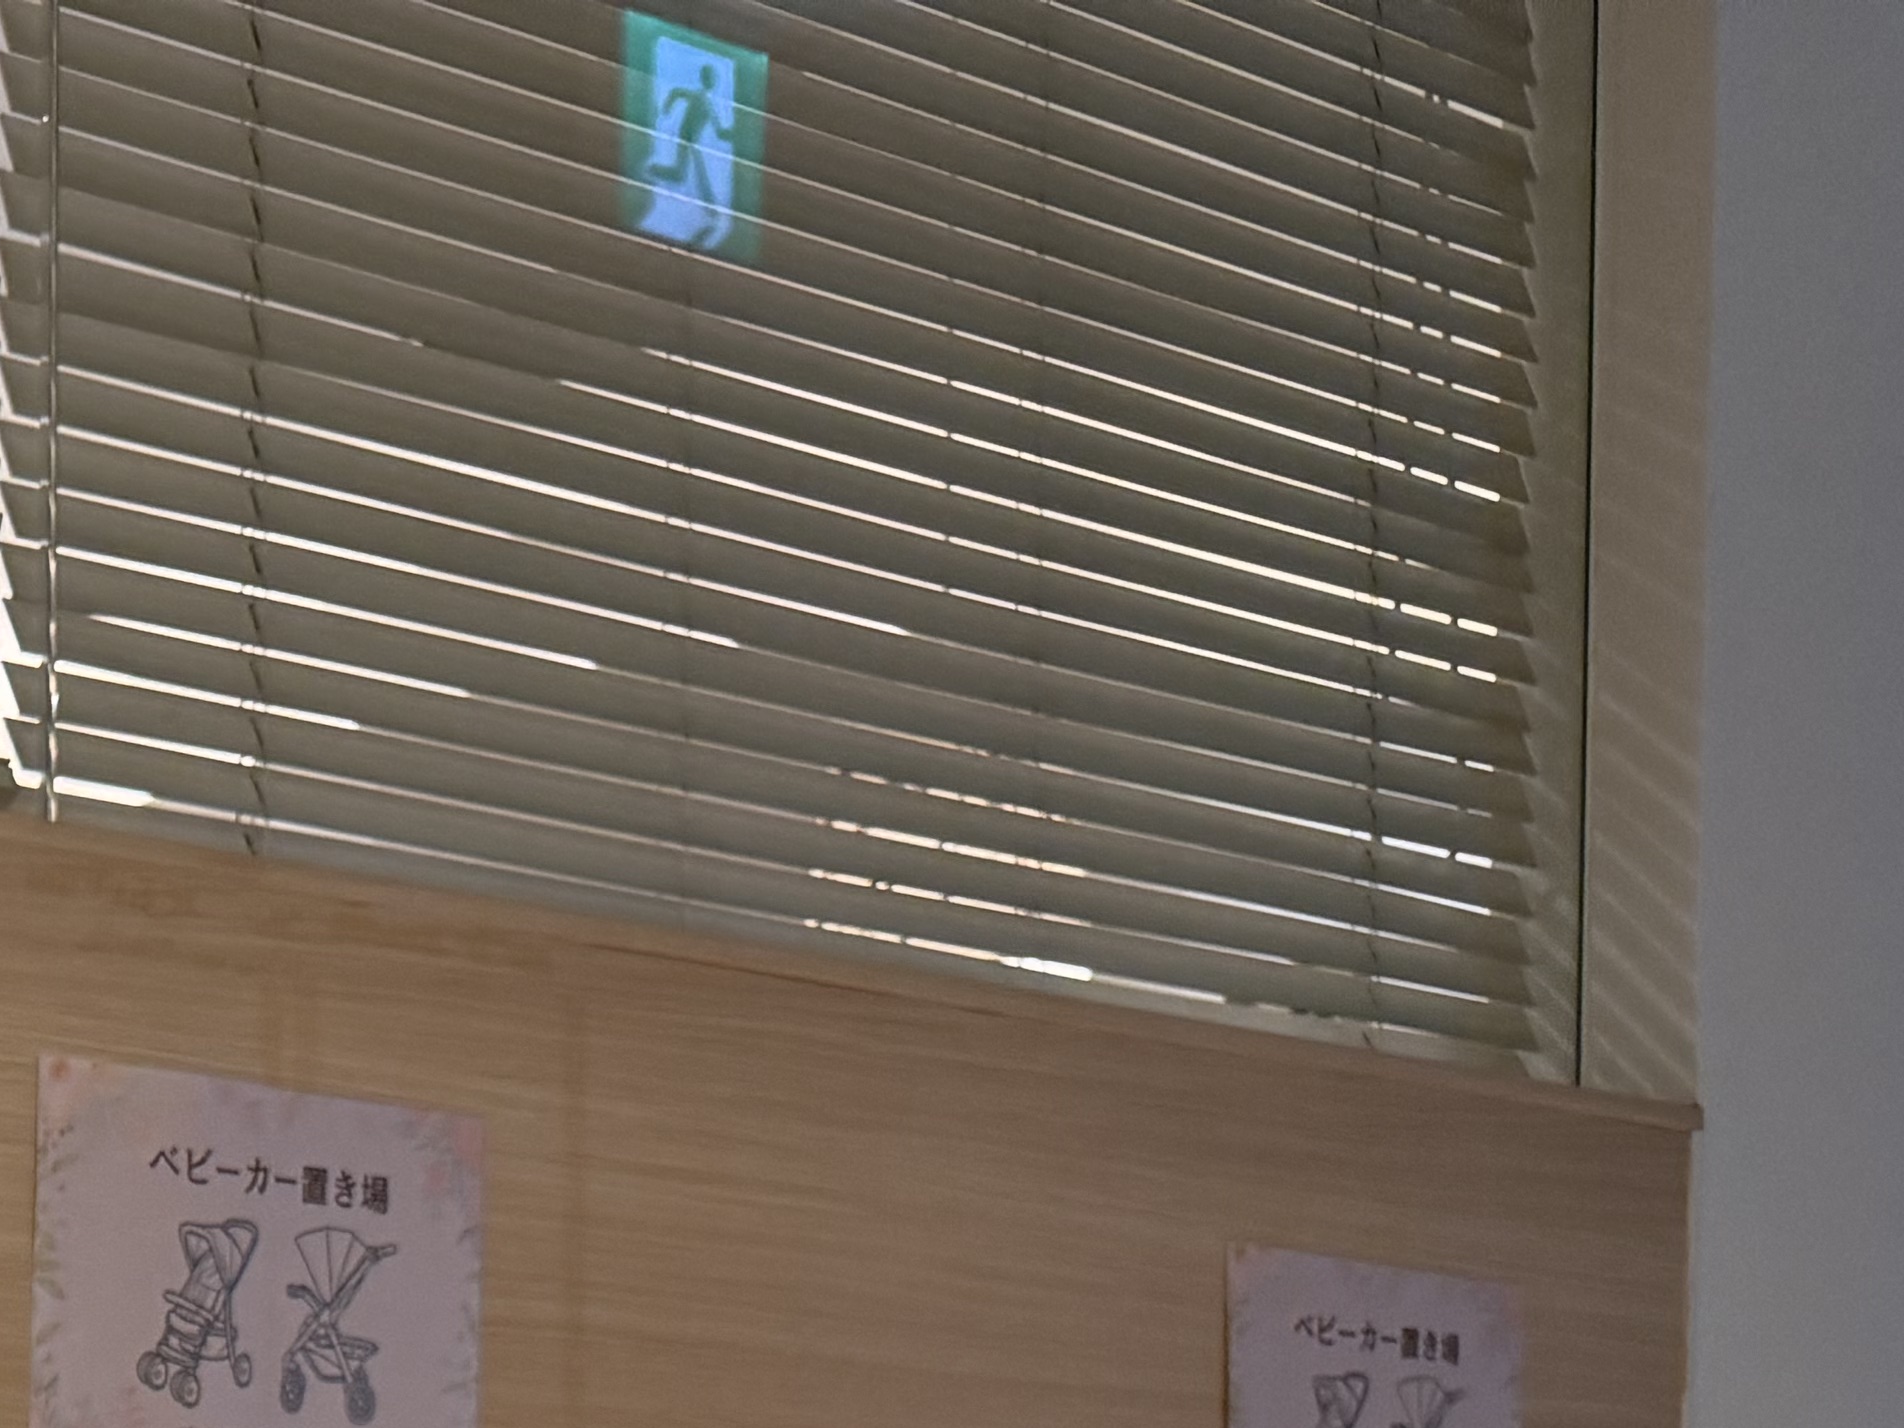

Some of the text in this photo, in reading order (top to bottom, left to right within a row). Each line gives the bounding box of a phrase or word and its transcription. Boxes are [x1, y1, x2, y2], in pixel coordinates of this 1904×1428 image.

[149, 1148, 390, 1215] ベビーカー置き場
